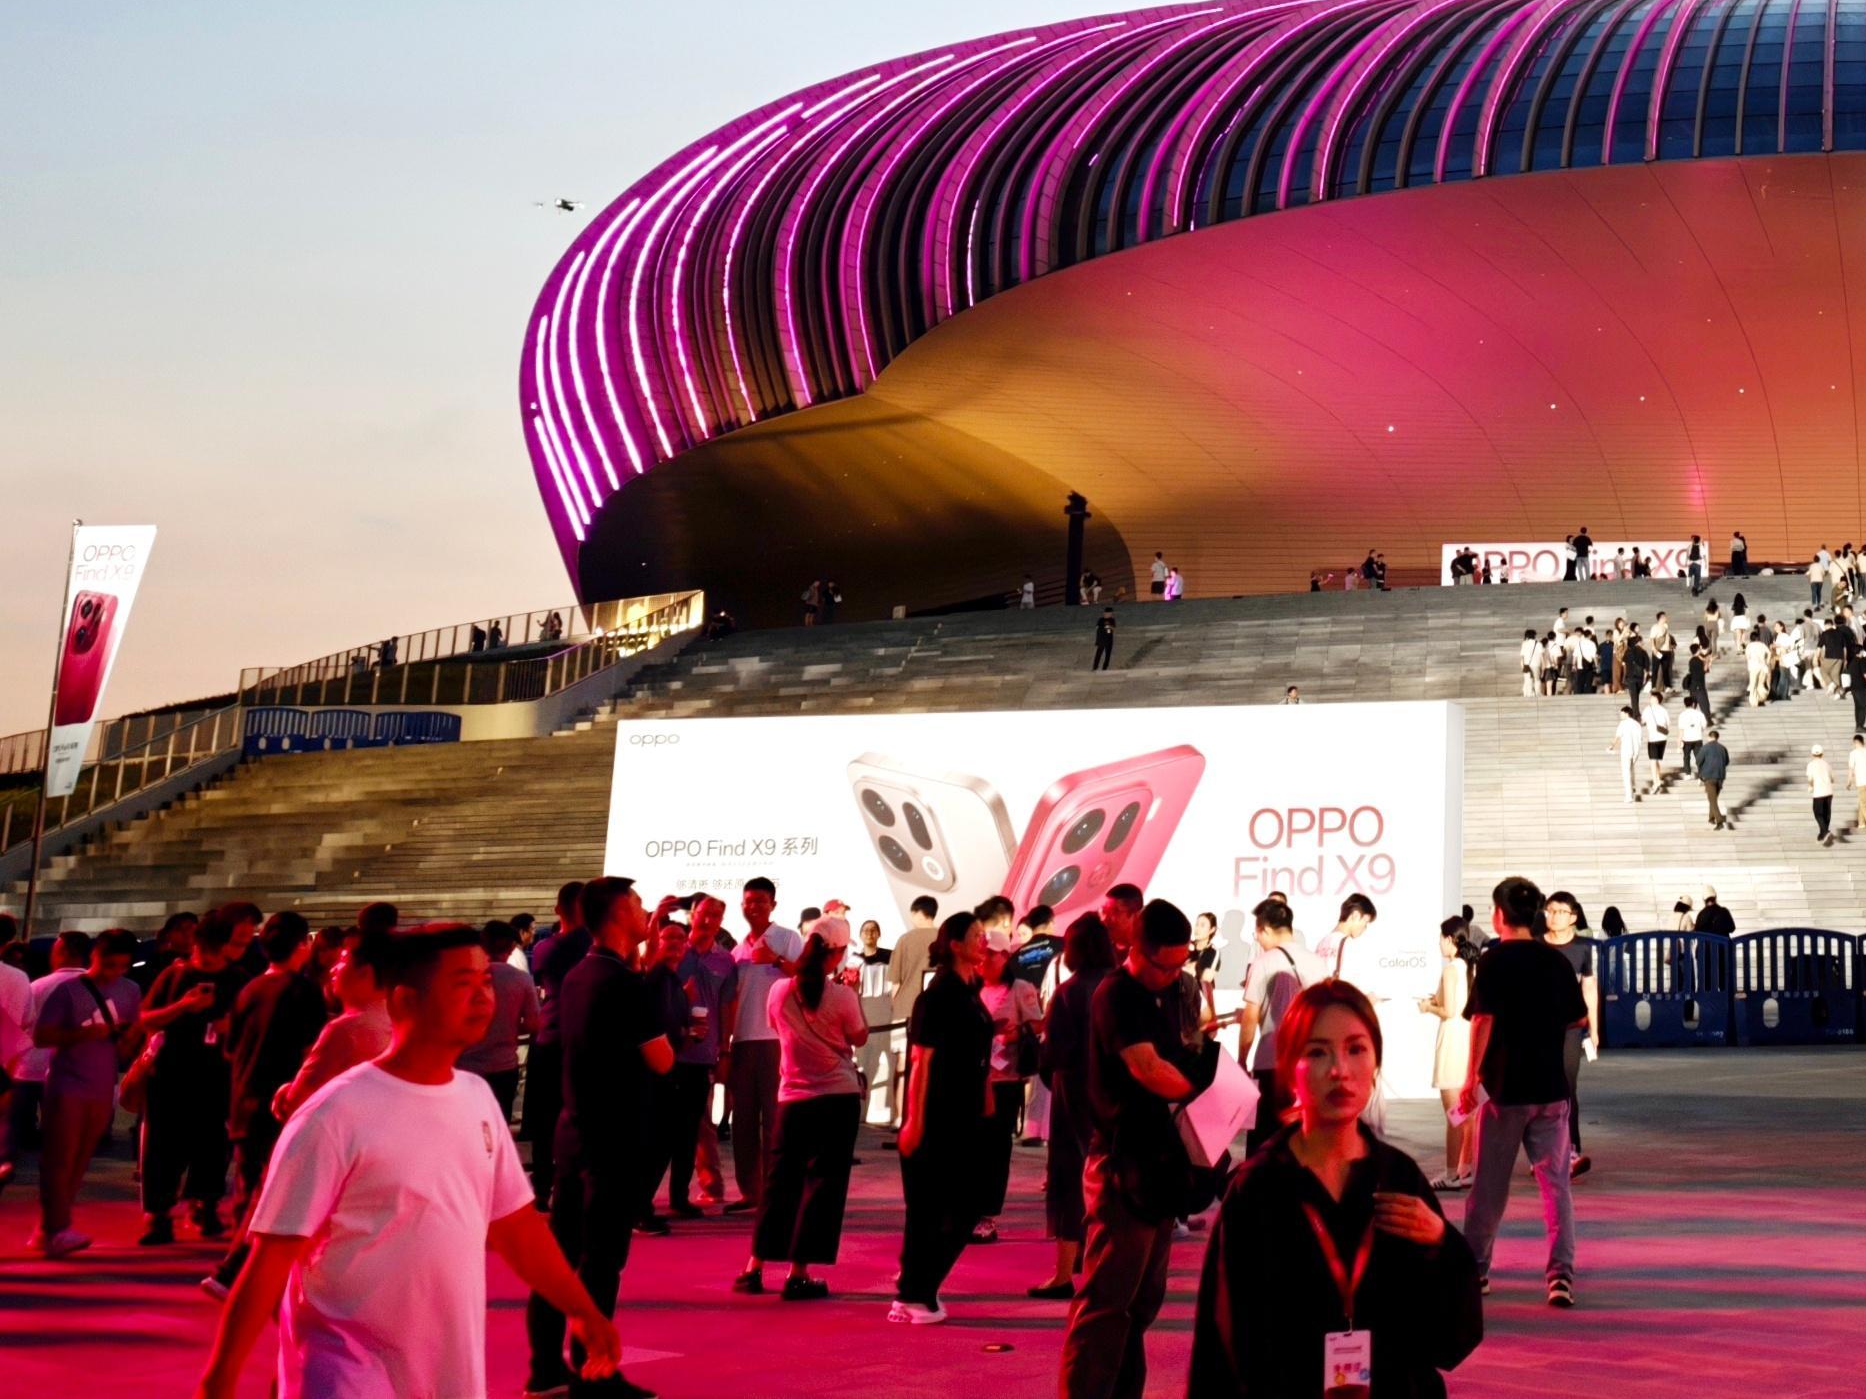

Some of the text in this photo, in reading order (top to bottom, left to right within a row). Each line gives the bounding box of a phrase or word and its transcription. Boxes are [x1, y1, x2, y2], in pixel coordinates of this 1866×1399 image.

[1459, 550, 1560, 584] PPO
[645, 836, 819, 858] OPPO Find X9 系列
[1248, 805, 1384, 850] OPPO
[1233, 853, 1397, 897] Find X9
